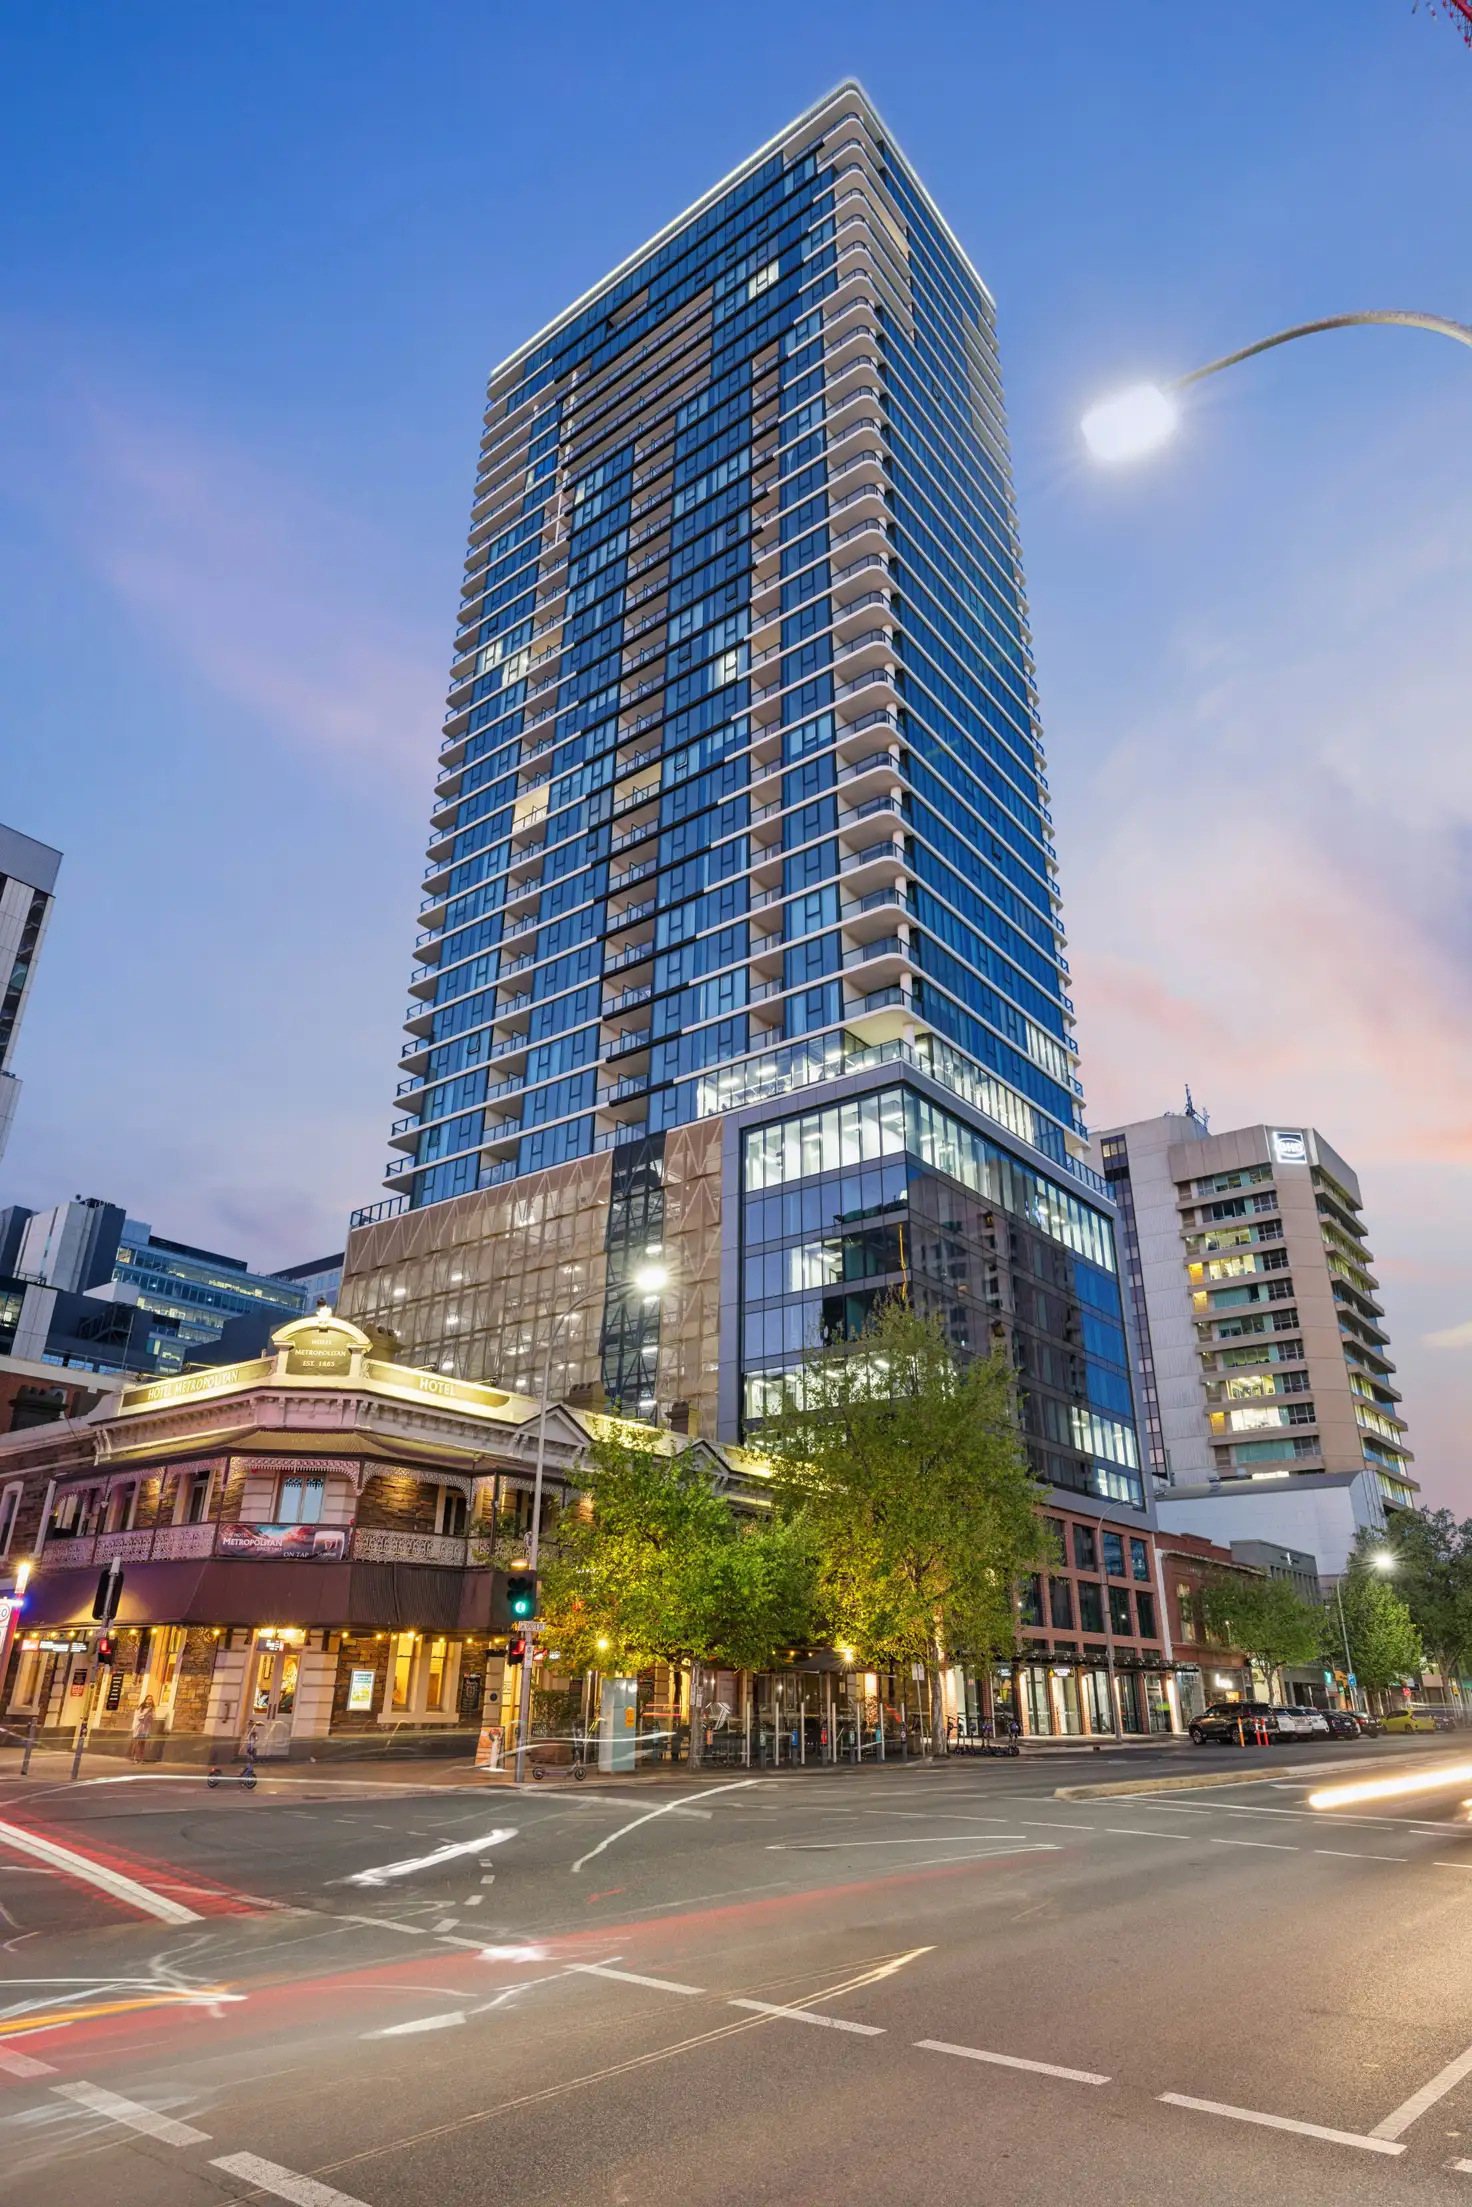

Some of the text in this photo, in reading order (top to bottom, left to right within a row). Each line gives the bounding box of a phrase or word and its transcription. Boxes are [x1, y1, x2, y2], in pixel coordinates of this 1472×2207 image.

[295, 1349, 347, 1357] METROPOLITAN
[147, 1370, 239, 1401] HOTEL METROPOLITAN
[419, 1377, 457, 1397] HOTEL
[222, 1538, 283, 1547] METROPOLITAN
